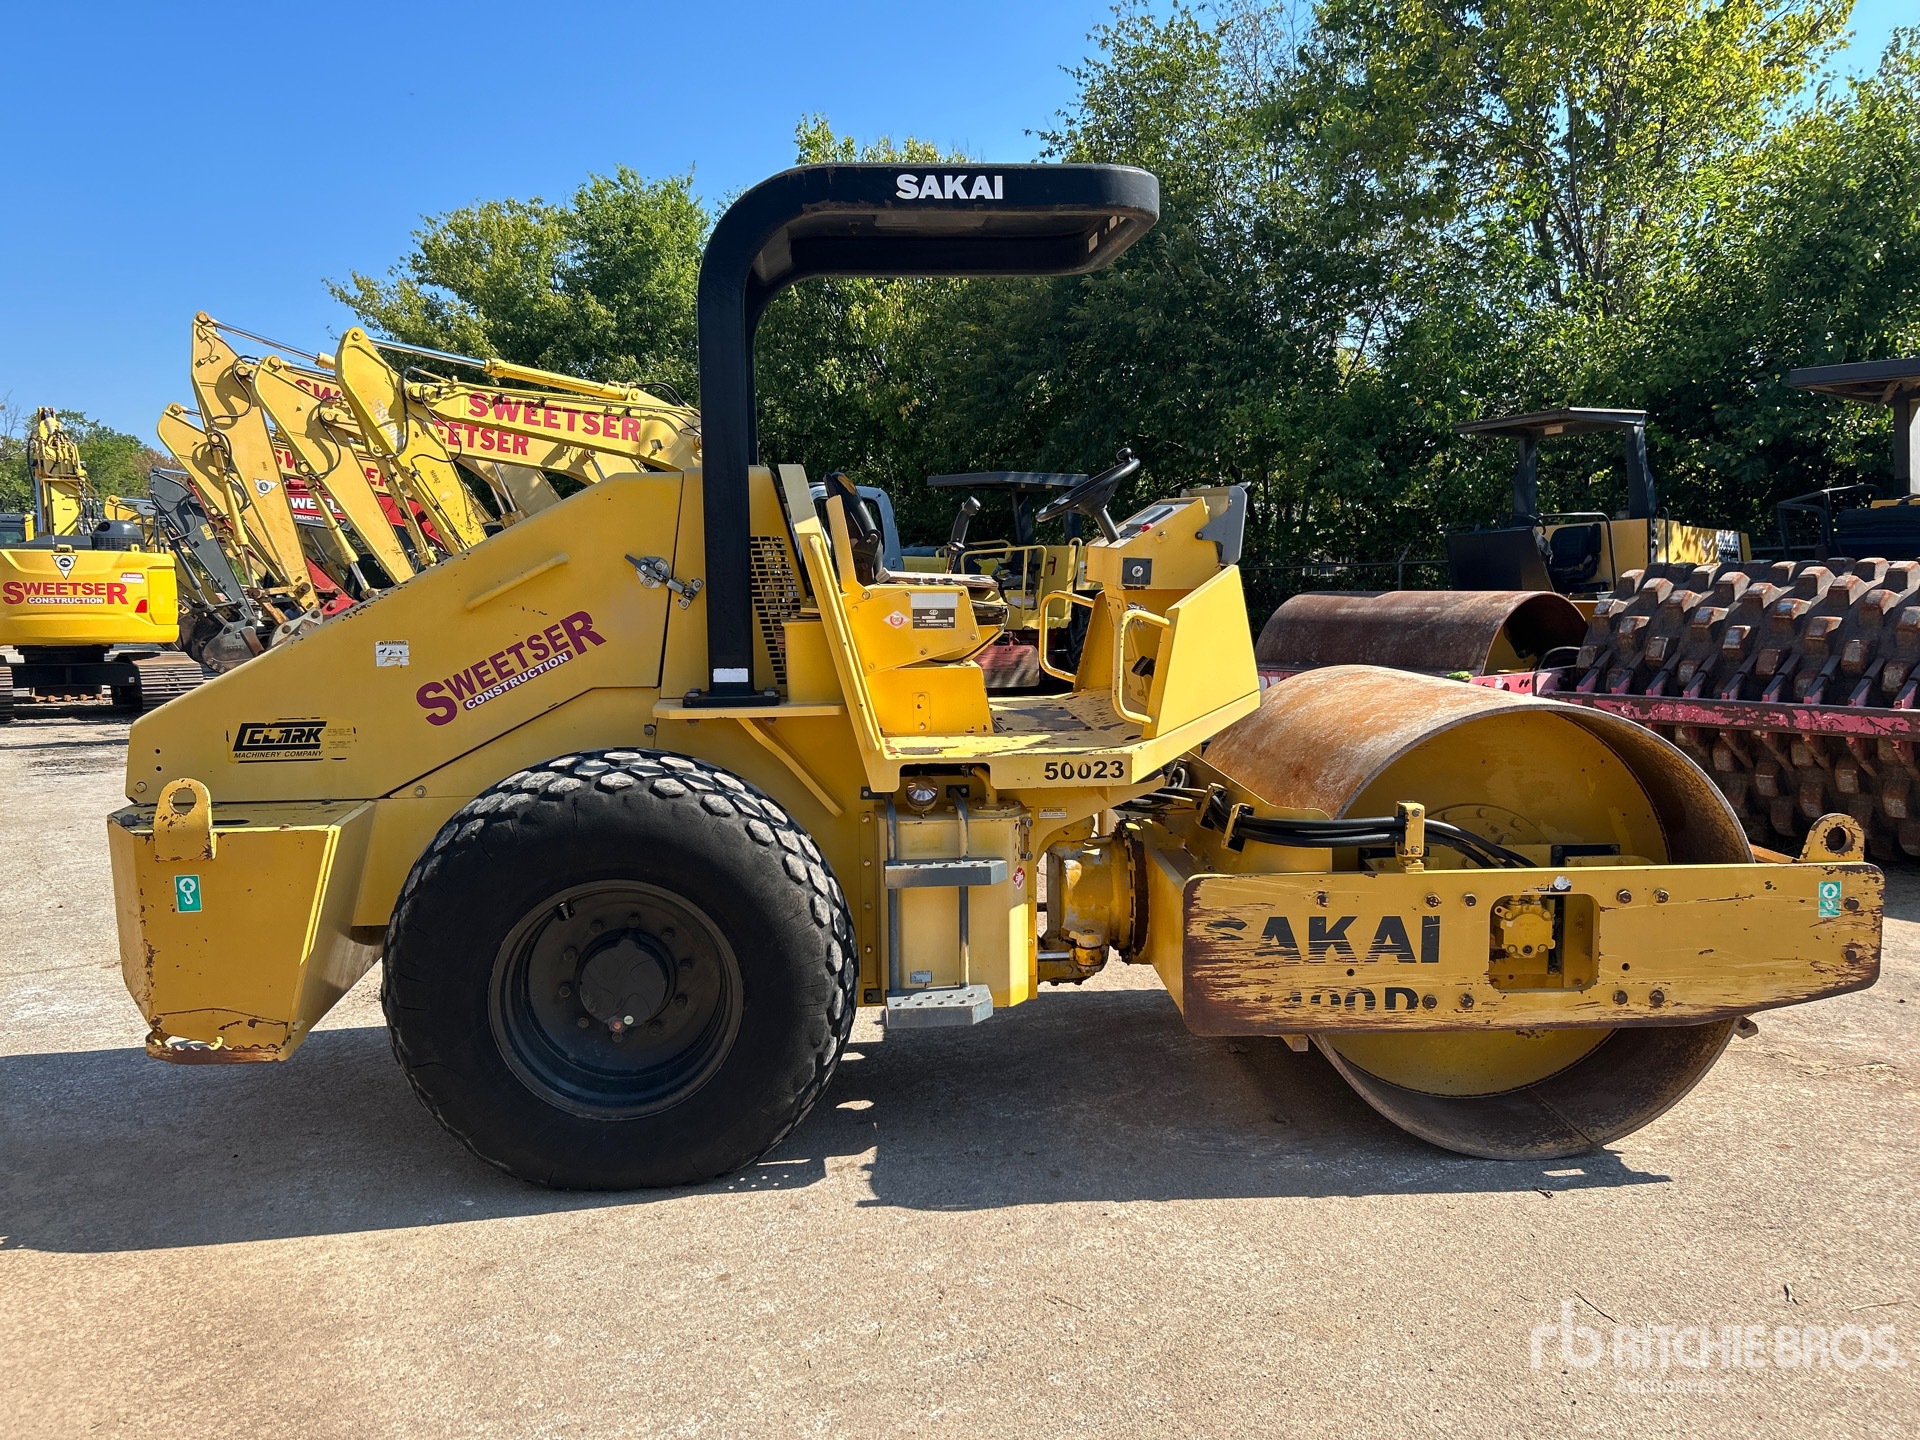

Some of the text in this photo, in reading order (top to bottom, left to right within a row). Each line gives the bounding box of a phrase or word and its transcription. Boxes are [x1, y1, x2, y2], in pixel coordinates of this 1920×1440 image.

[895, 174, 1004, 200] SAKAI
[468, 393, 641, 443] SWEETSER
[434, 420, 529, 456] EETSER
[3, 582, 129, 605] SWEETSER
[416, 611, 607, 726] SWEETSER
[466, 653, 568, 709] CONSTRUCTION
[1044, 760, 1125, 780] 50023
